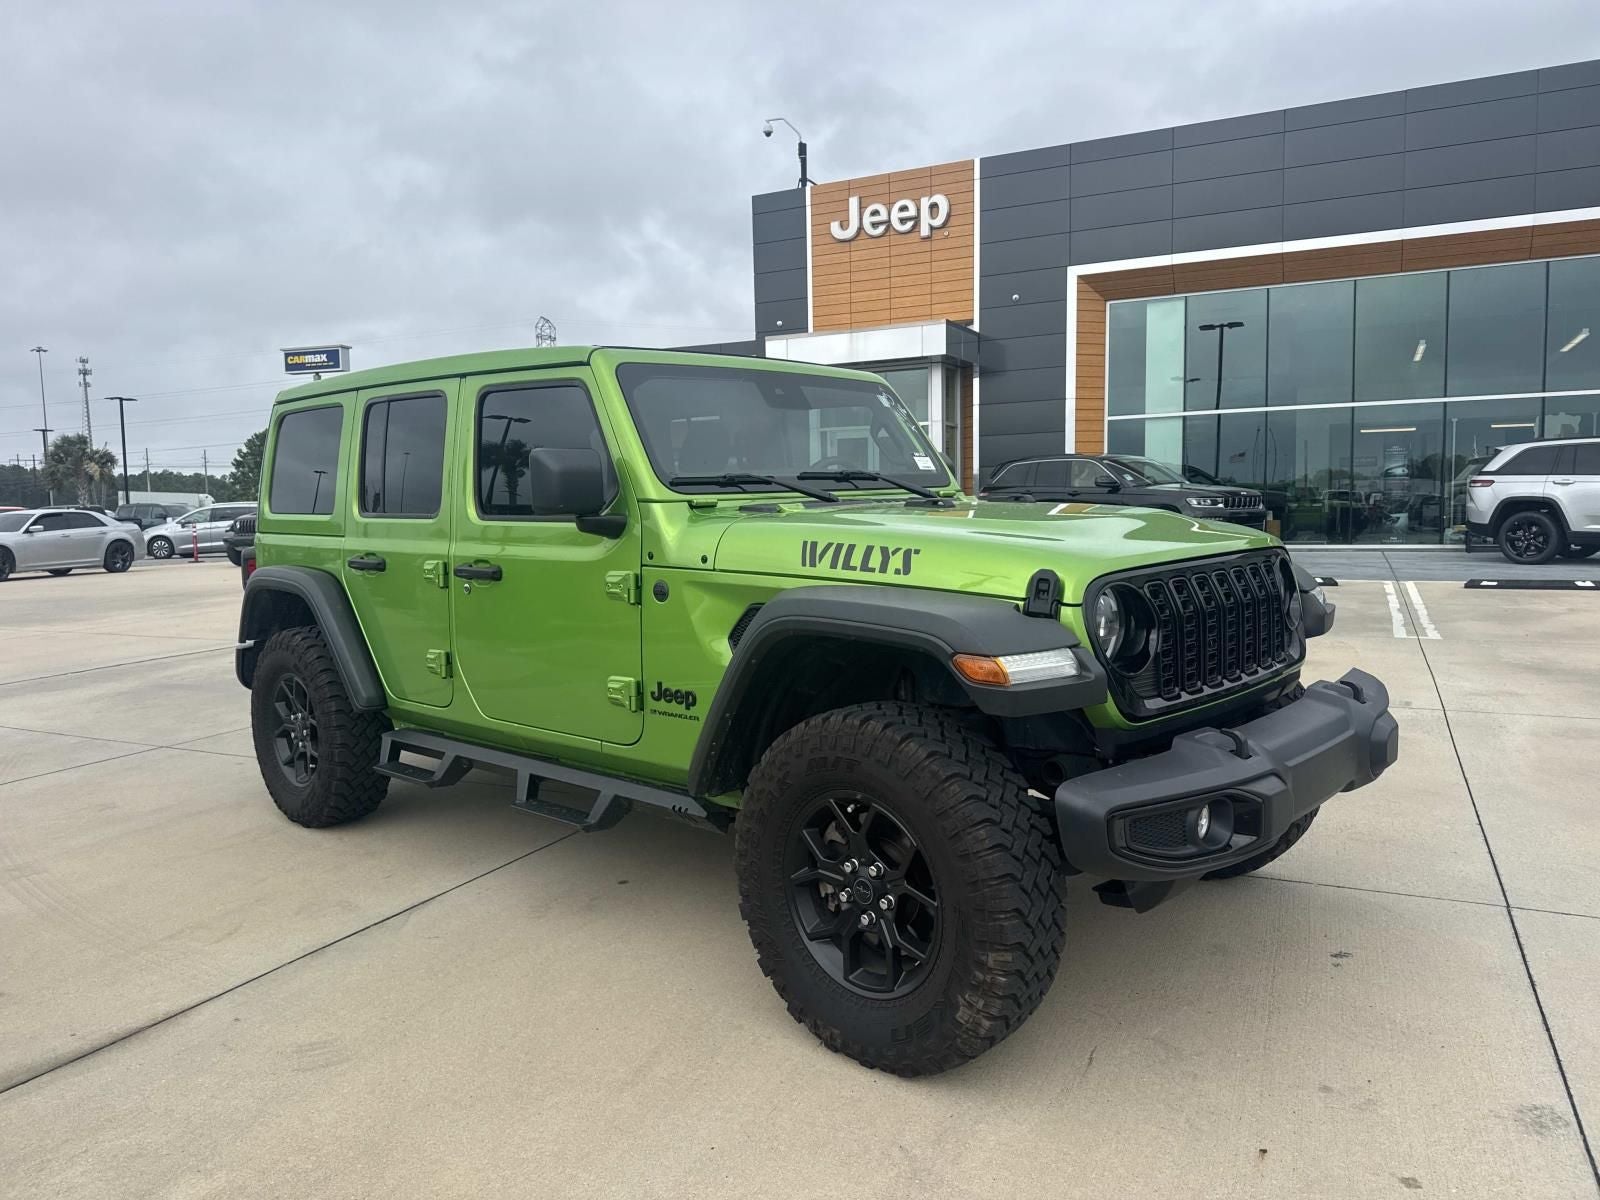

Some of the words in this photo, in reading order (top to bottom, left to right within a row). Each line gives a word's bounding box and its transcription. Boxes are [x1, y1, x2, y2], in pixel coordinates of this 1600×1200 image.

[830, 193, 951, 241] Jeep
[801, 540, 921, 575] WILLYS
[650, 680, 697, 711] Jeep
